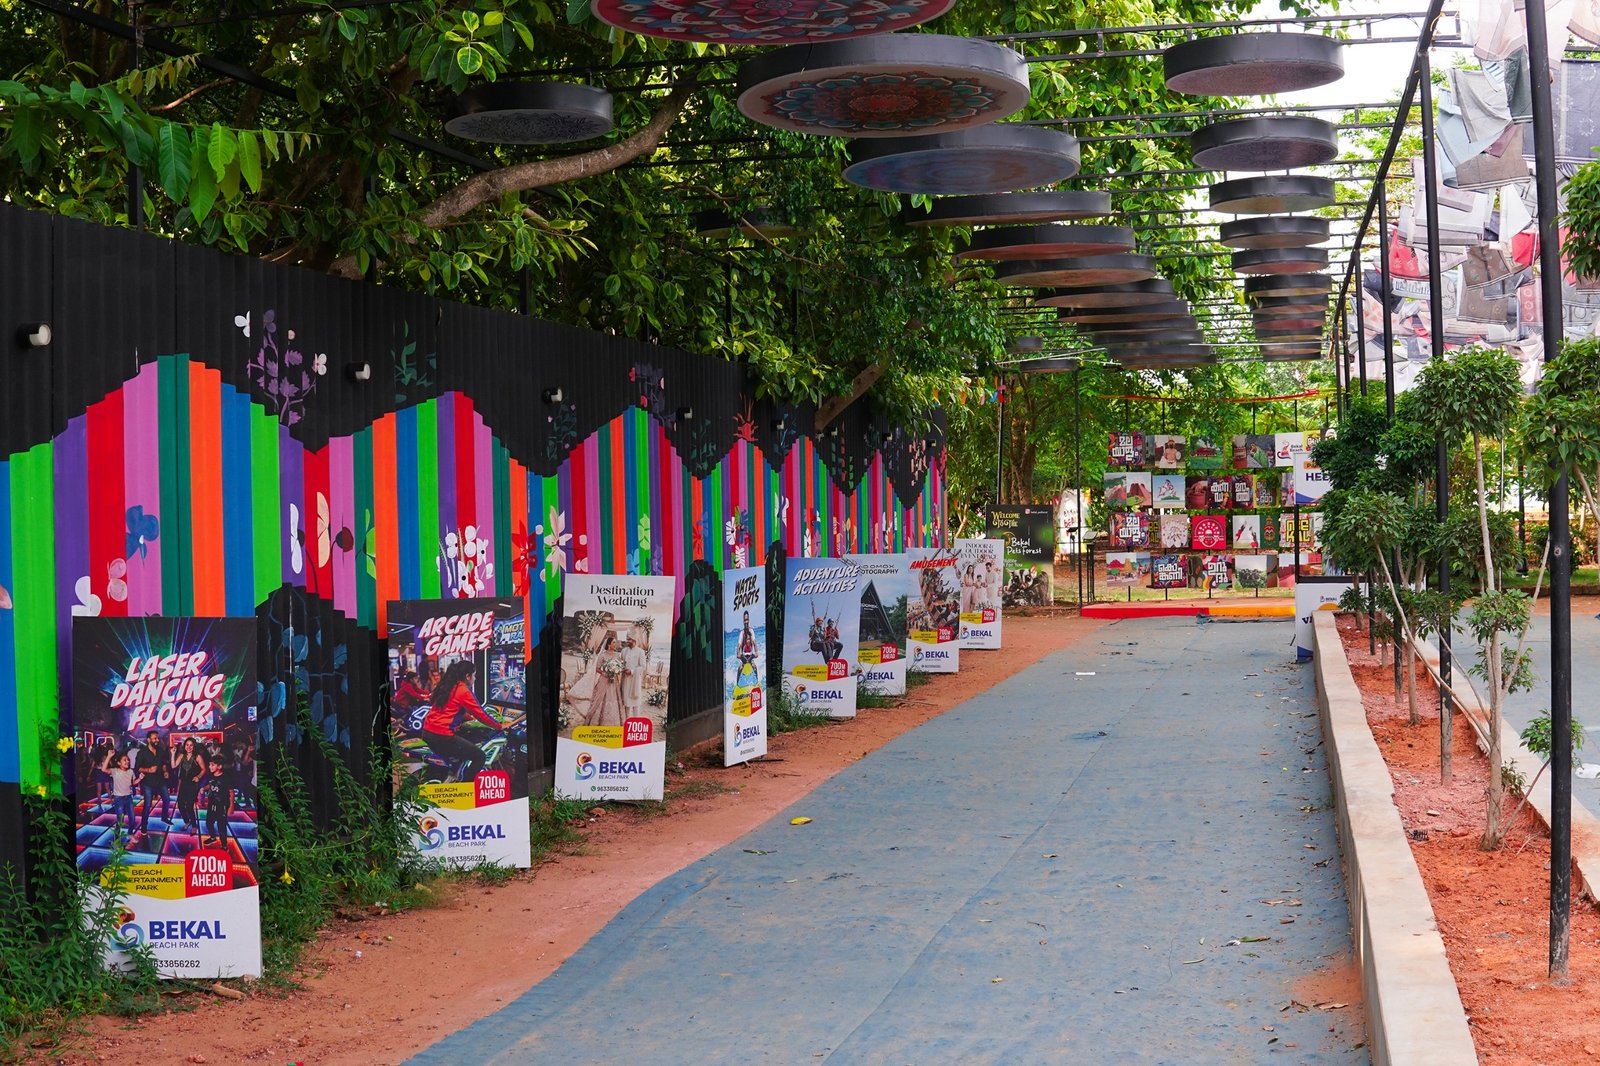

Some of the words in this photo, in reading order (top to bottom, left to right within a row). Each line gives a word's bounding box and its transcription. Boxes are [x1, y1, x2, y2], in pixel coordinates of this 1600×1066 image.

[1011, 537, 1031, 547] Bekal
[909, 557, 959, 570] AMUSEMENT
[793, 565, 861, 582] ADVENTURE
[590, 584, 655, 597] Destination
[735, 574, 757, 595] WATER
[793, 579, 857, 596] ACTIVITIES
[597, 595, 648, 609] Wedding
[733, 588, 760, 611] SPORTS
[417, 610, 495, 639] ARCADE
[970, 629, 992, 637] BEKAL
[425, 629, 493, 657] GAMES
[925, 651, 950, 659] BEKAL
[125, 651, 208, 682] LASER
[866, 671, 895, 681] BEKAL
[110, 673, 227, 709] DANCING
[811, 690, 844, 700] BEKAL
[127, 699, 214, 732] FLOOR
[626, 721, 649, 733] 700M
[742, 725, 760, 739] BEKAL
[626, 732, 648, 742] AHEAD
[599, 761, 646, 774] BEKAL
[477, 775, 506, 789] 700M
[479, 788, 506, 800] AHEAD
[448, 824, 506, 841] BEKAL
[189, 855, 227, 873] 700M
[191, 873, 226, 887] AHEAD
[149, 920, 227, 940] BEKAL
[150, 941, 177, 949] BEACH
[179, 941, 200, 949] PARK
[153, 959, 201, 968] 633856262
